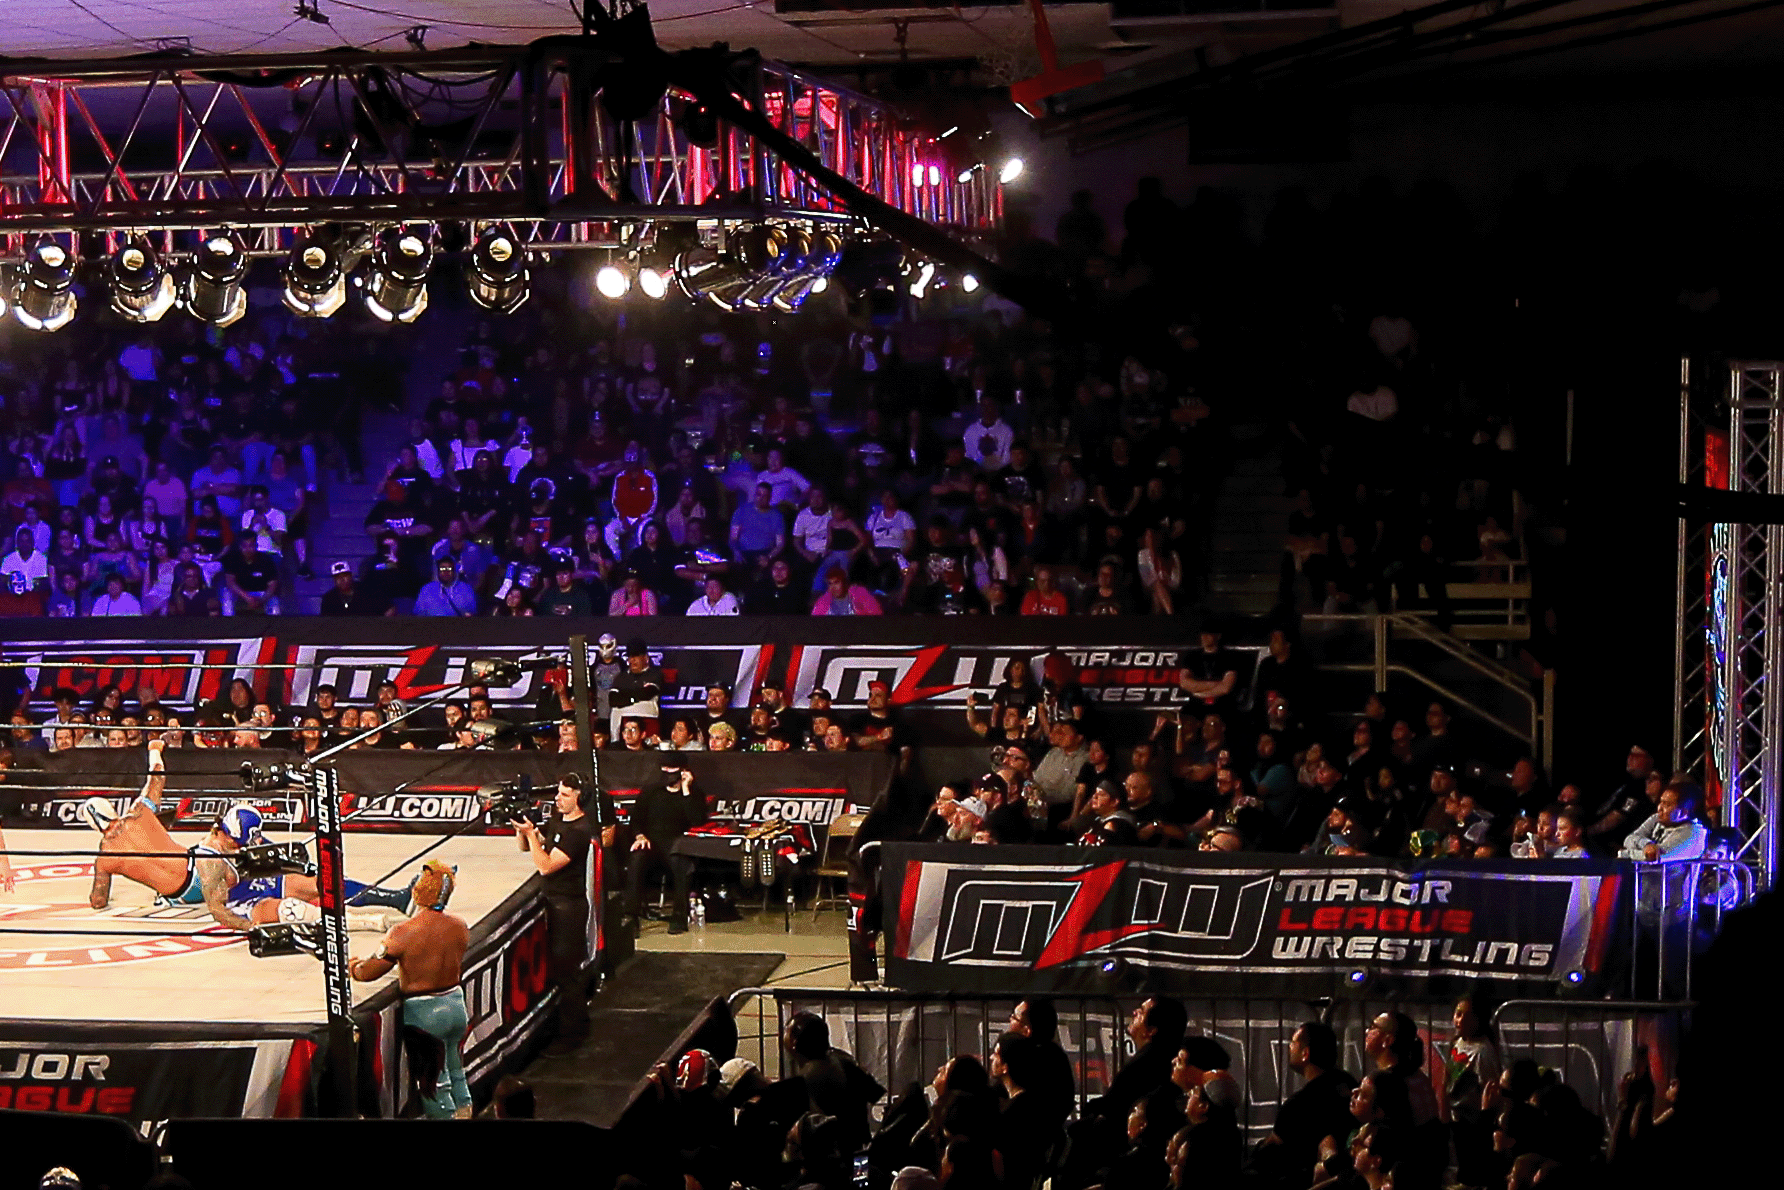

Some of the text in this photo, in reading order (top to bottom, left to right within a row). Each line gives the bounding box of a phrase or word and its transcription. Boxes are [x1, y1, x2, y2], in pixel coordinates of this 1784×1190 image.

[314, 768, 330, 834] MAJOR
[319, 838, 335, 909] LEAGUE
[1284, 878, 1453, 905] MAJOR
[1277, 905, 1474, 934] LEAGUE
[324, 914, 342, 1017] WRESTLING
[1271, 935, 1554, 967] WRESTLING
